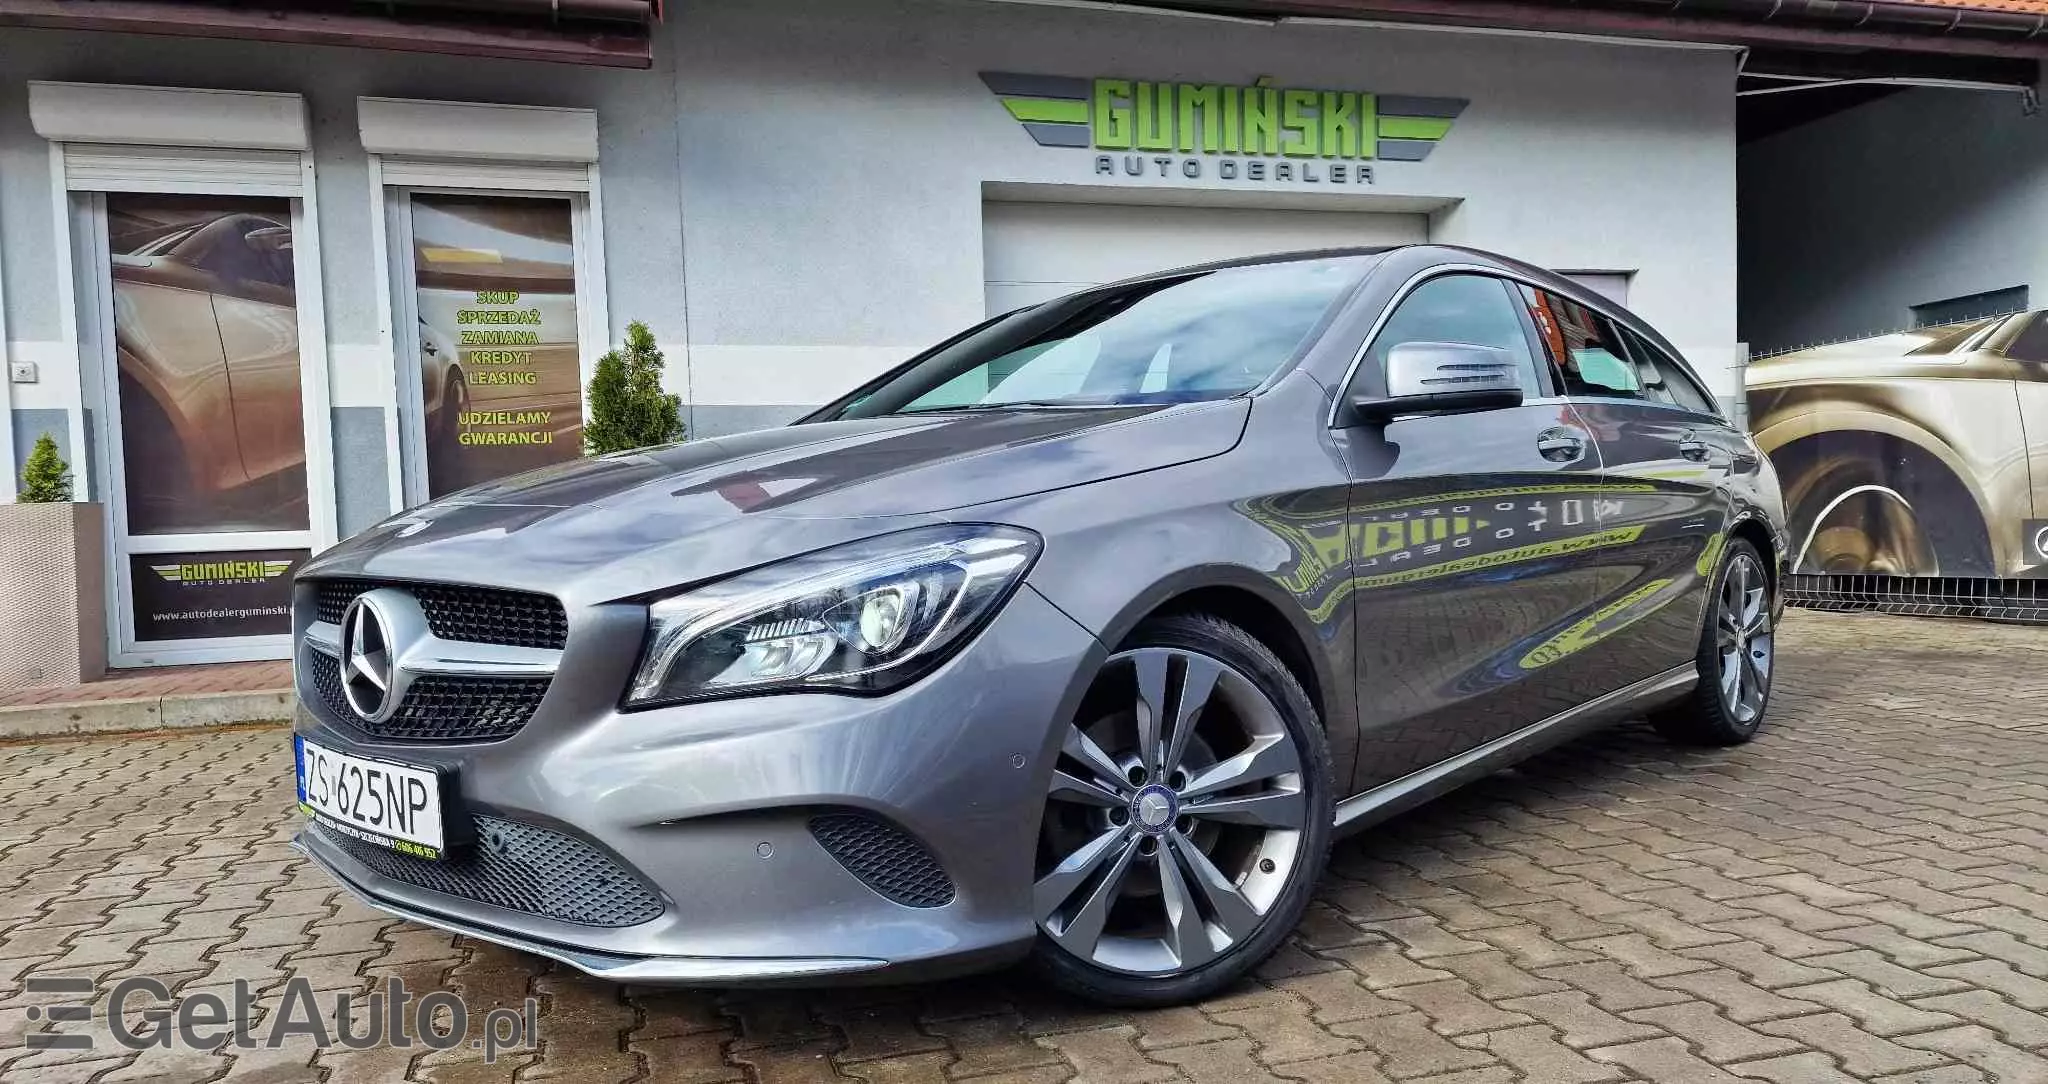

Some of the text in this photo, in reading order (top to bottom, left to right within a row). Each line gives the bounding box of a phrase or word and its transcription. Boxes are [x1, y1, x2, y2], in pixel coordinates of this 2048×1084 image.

[1094, 75, 1376, 160] GUMIŃSKI
[1095, 154, 1375, 185] AUTO DEALER
[477, 290, 519, 304] SKUP
[457, 309, 541, 324] SPRZEDAŻ
[461, 331, 540, 345] ZAMIANA
[470, 351, 533, 365] KREDYT
[469, 371, 537, 385] LEASING
[458, 411, 552, 425] UDZIELAMY
[458, 431, 553, 445] GWARANCJI
[181, 560, 264, 580] GUMIŃSKI
[306, 748, 329, 807] ZS
[337, 762, 427, 836] 625NP
